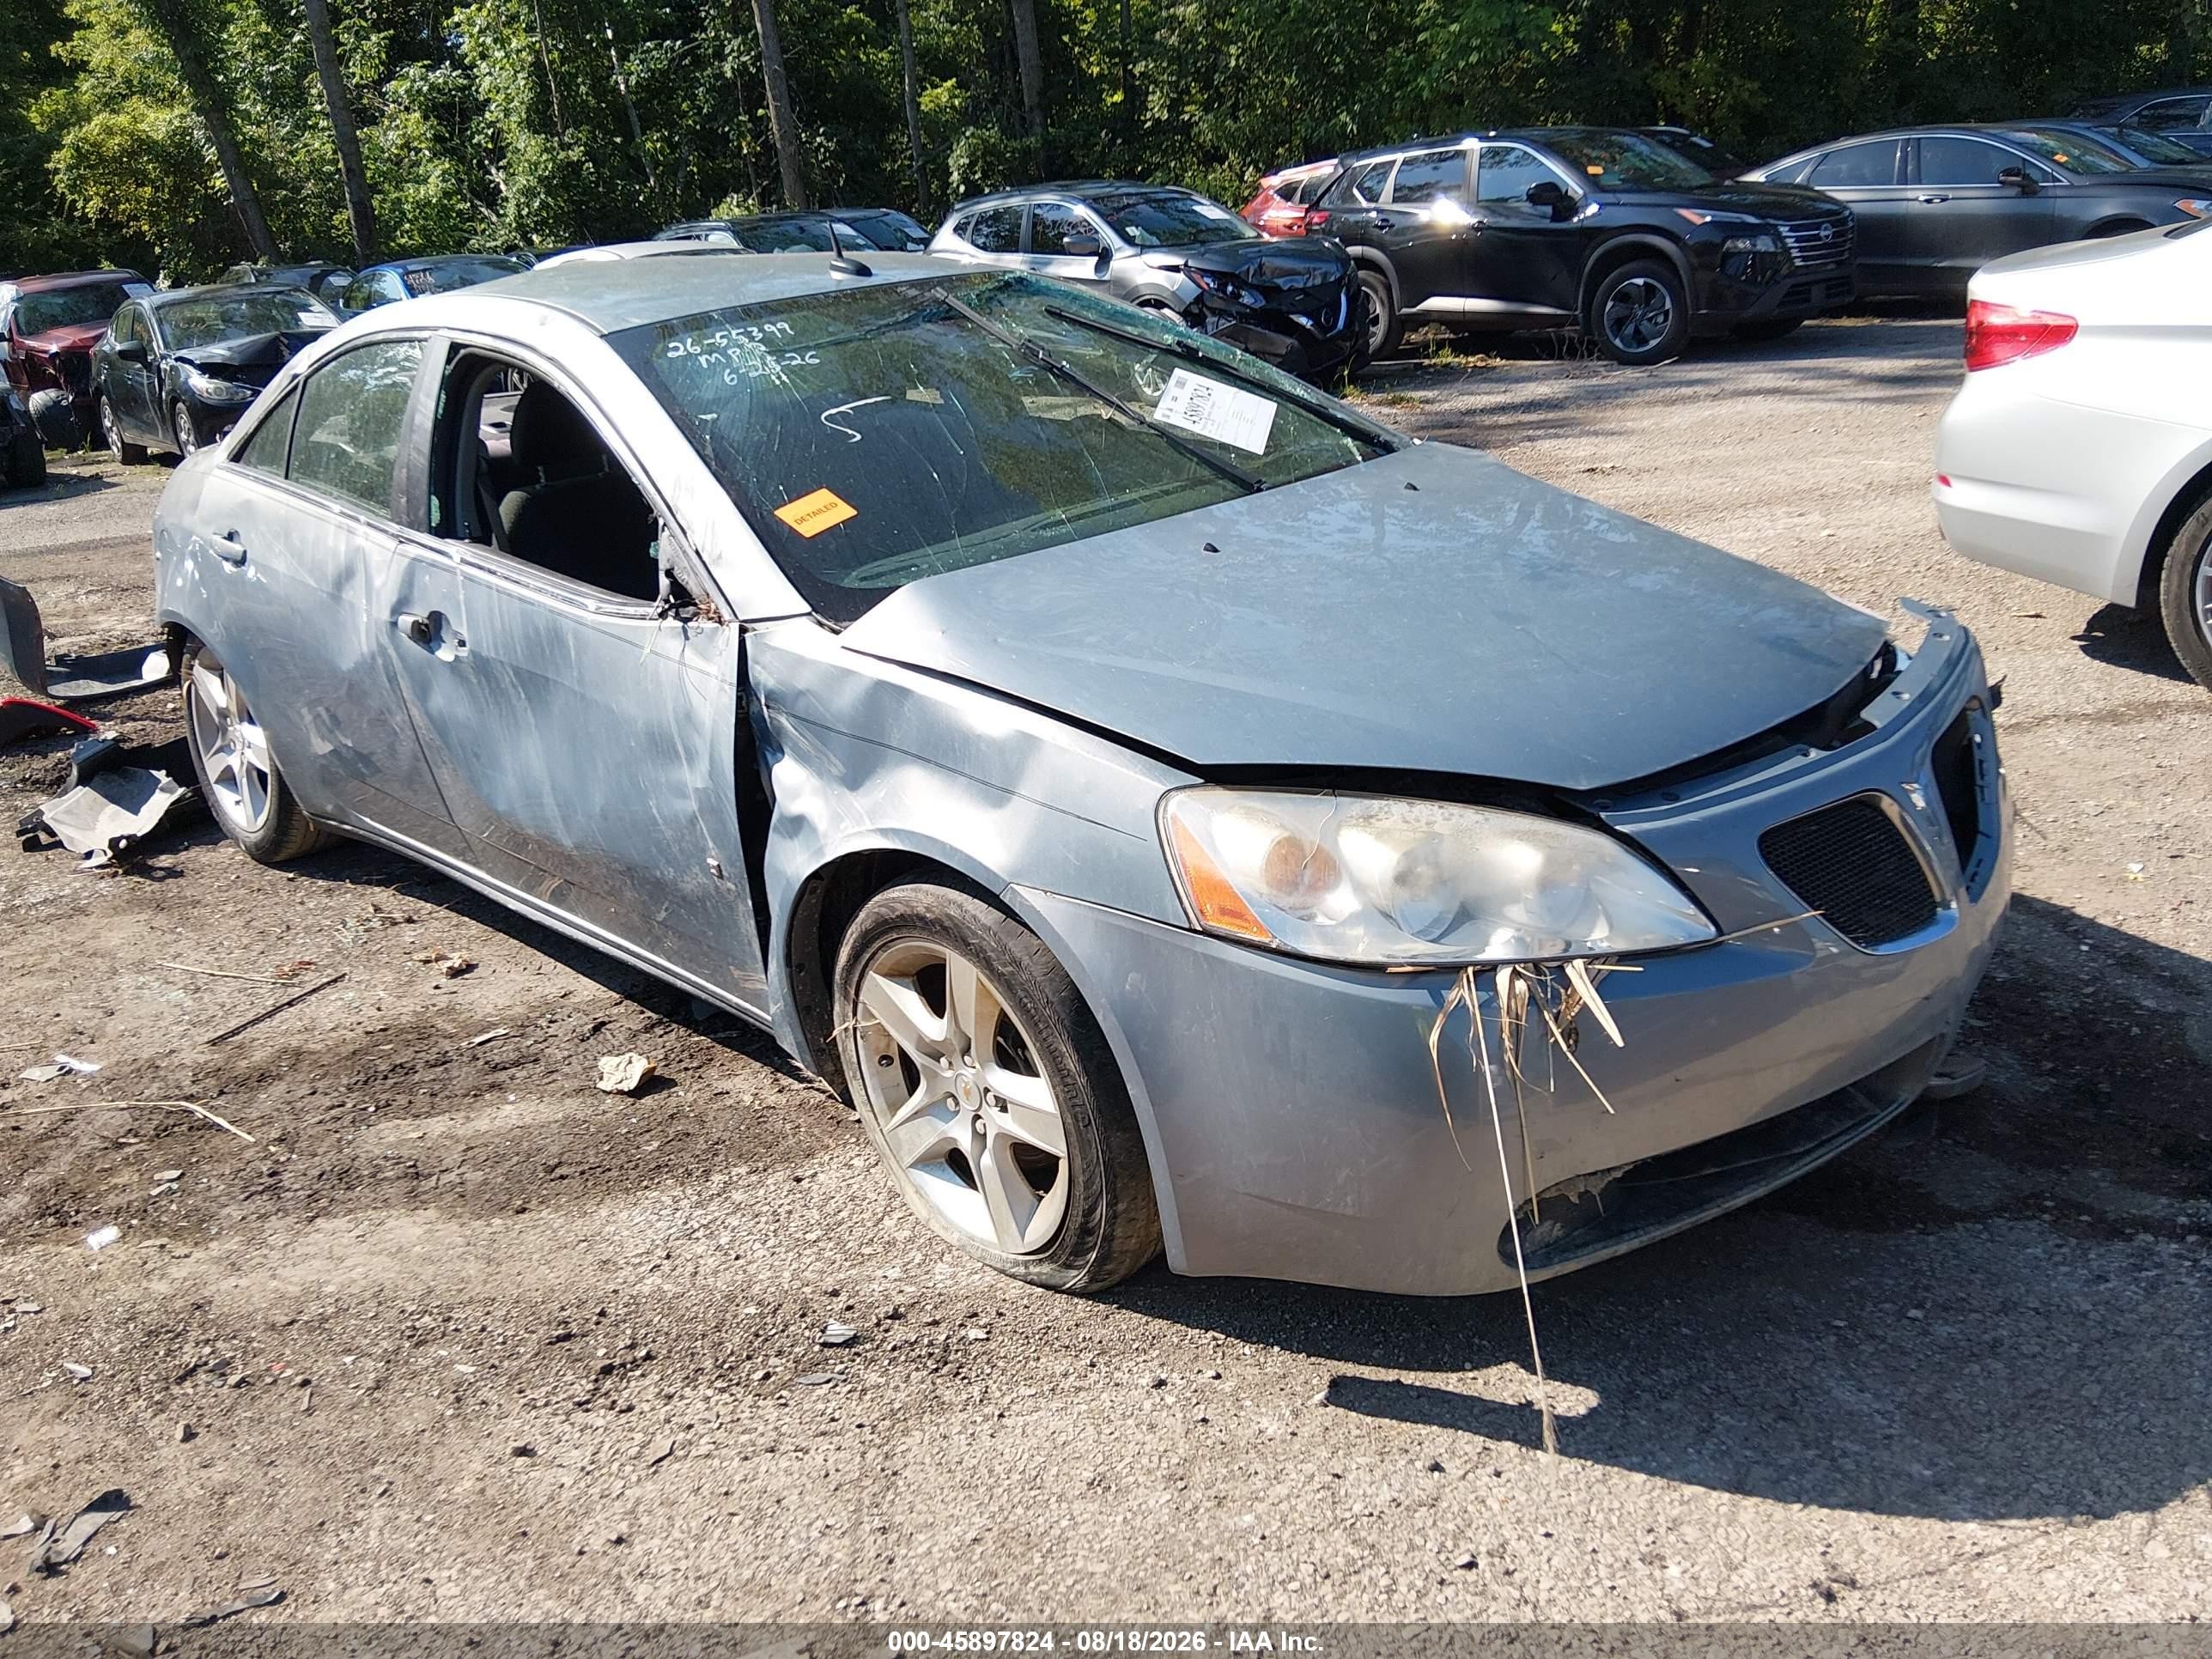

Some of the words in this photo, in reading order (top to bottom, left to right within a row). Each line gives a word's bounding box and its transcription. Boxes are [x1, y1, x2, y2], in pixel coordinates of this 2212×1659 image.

[666, 321, 795, 358] 26-55399
[1182, 383, 1214, 425] 45897824
[793, 501, 839, 526] DETAILED
